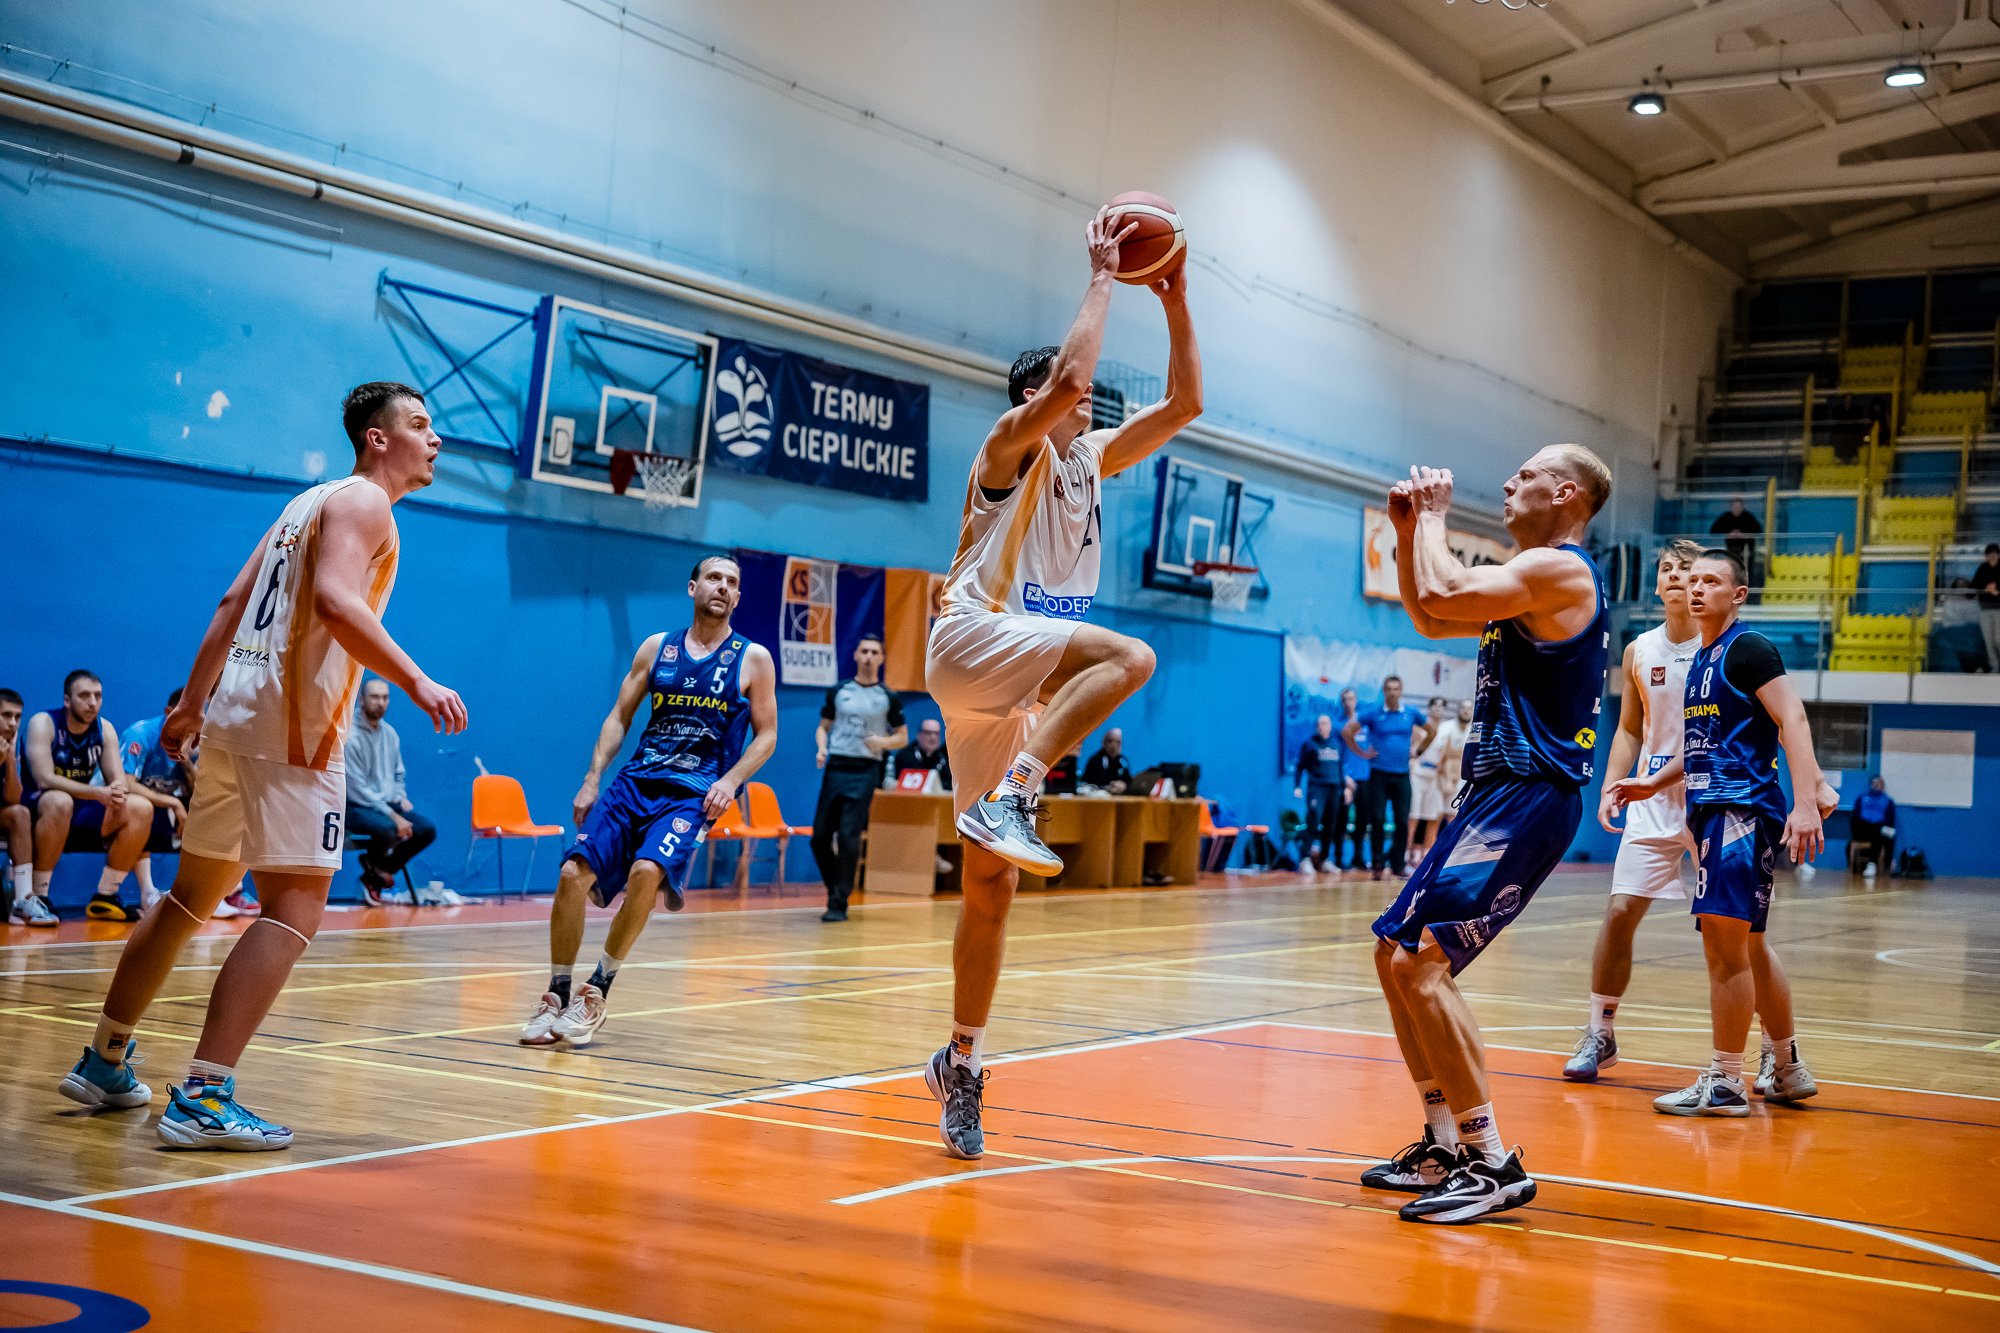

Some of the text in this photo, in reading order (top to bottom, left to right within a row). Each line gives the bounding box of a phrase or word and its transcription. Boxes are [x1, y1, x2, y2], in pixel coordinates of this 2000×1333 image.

[810, 381, 894, 431] TERMY
[782, 423, 917, 480] CIEPLICKIE
[254, 558, 285, 631] 6
[784, 647, 832, 667] SUDETY
[710, 667, 728, 694] 5
[1700, 667, 1713, 699] 8
[667, 694, 728, 712] ZETKAMA
[322, 812, 340, 851] 6
[658, 832, 681, 857] 5
[1695, 867, 1708, 899] 8
